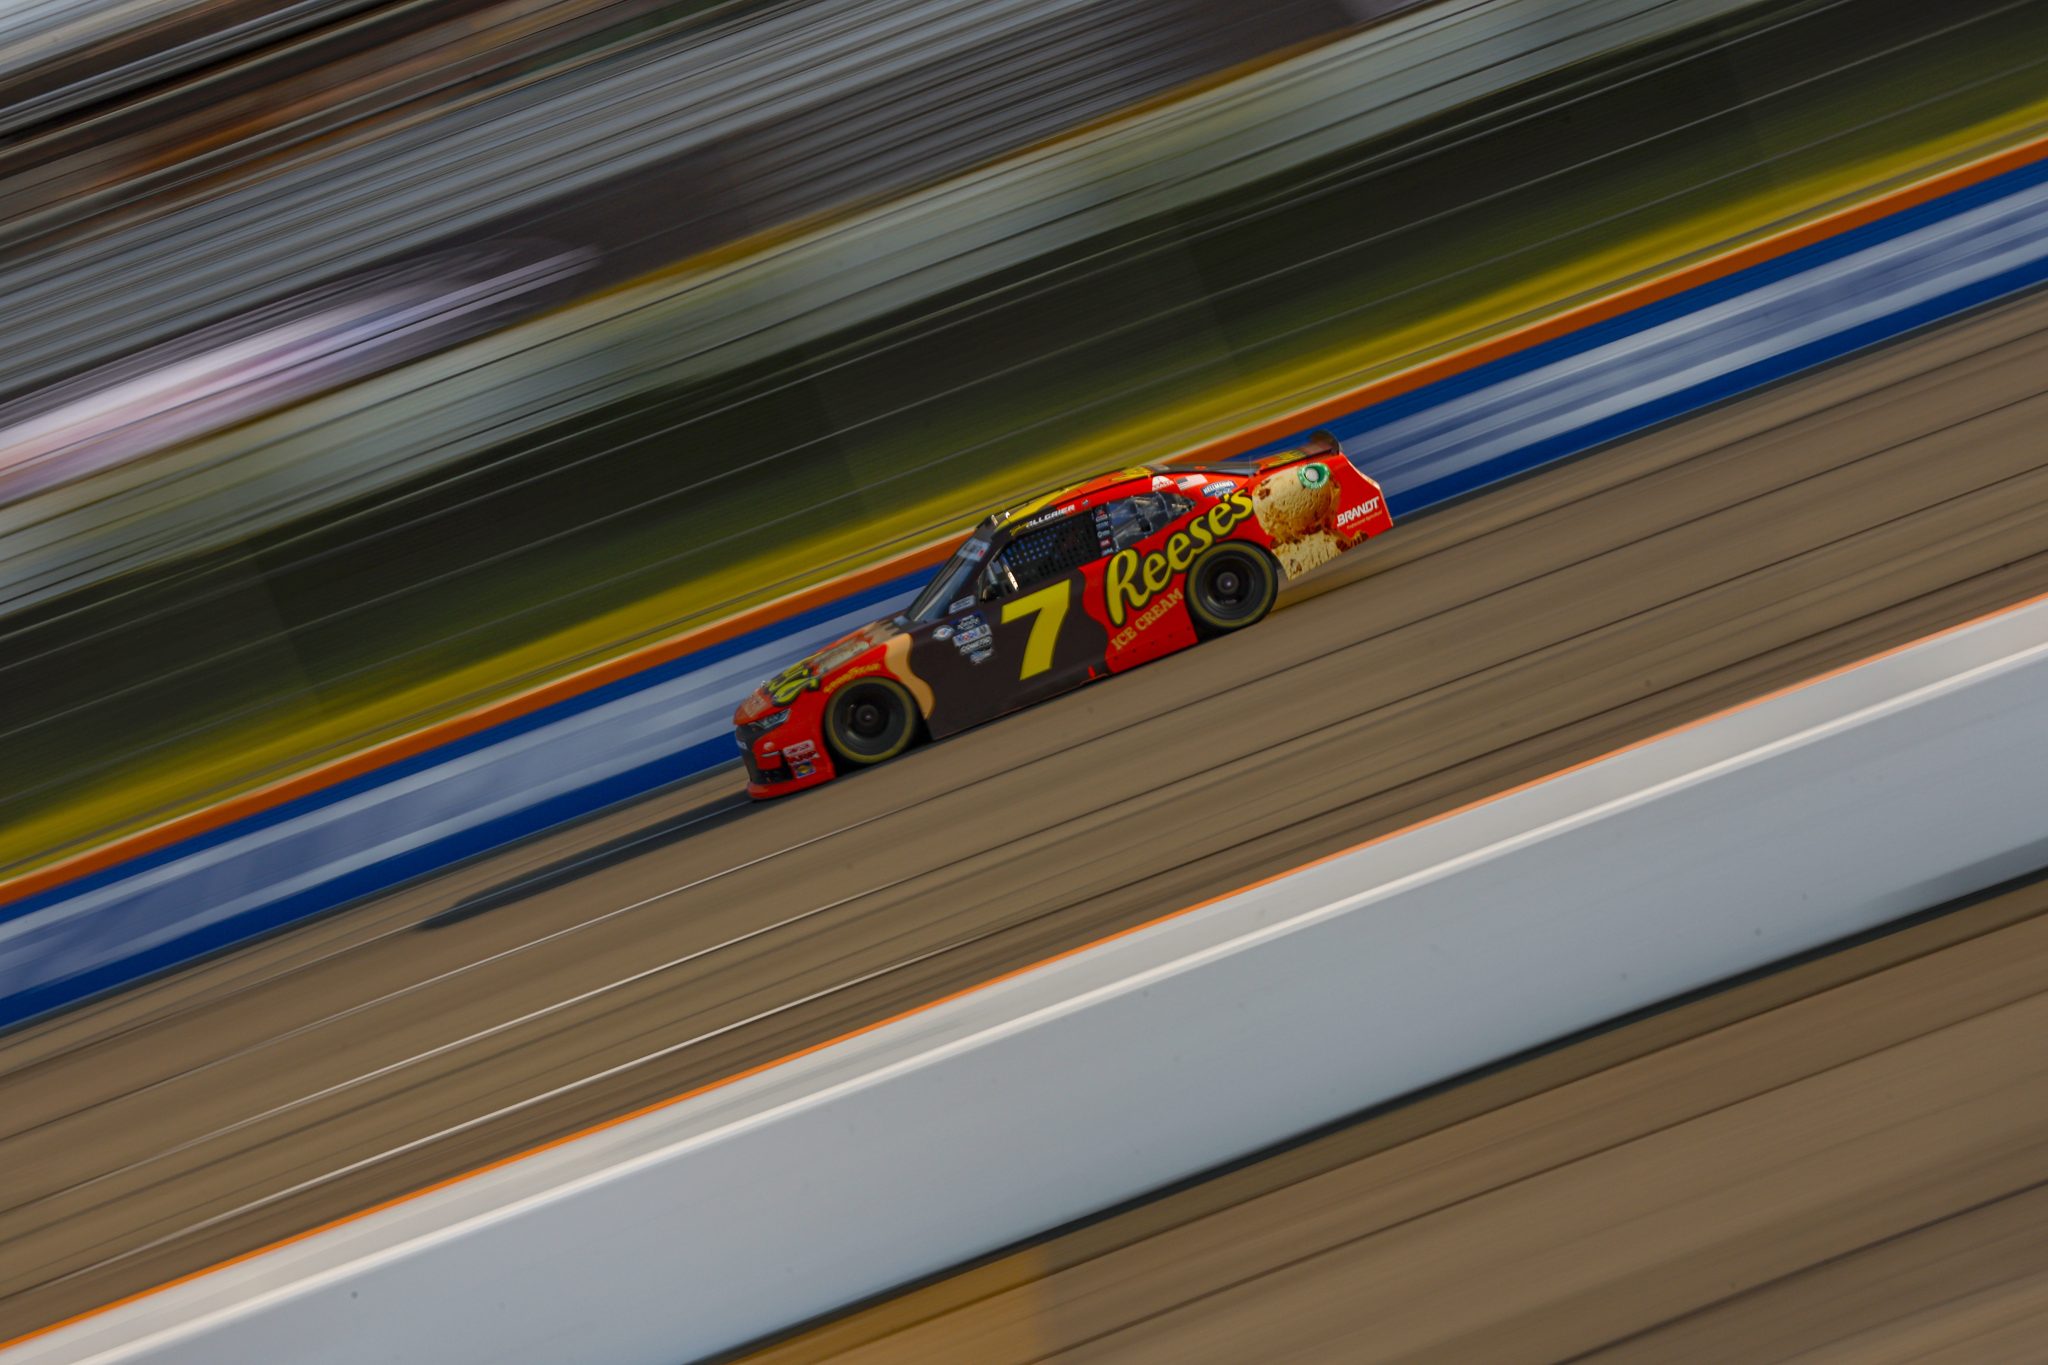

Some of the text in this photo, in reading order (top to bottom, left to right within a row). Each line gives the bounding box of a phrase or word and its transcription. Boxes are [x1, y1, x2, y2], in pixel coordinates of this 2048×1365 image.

[1337, 496, 1379, 527] BRANDT
[1107, 489, 1253, 625] Reese's
[1001, 579, 1070, 680] 7
[1111, 587, 1184, 650] ICE CREAM
